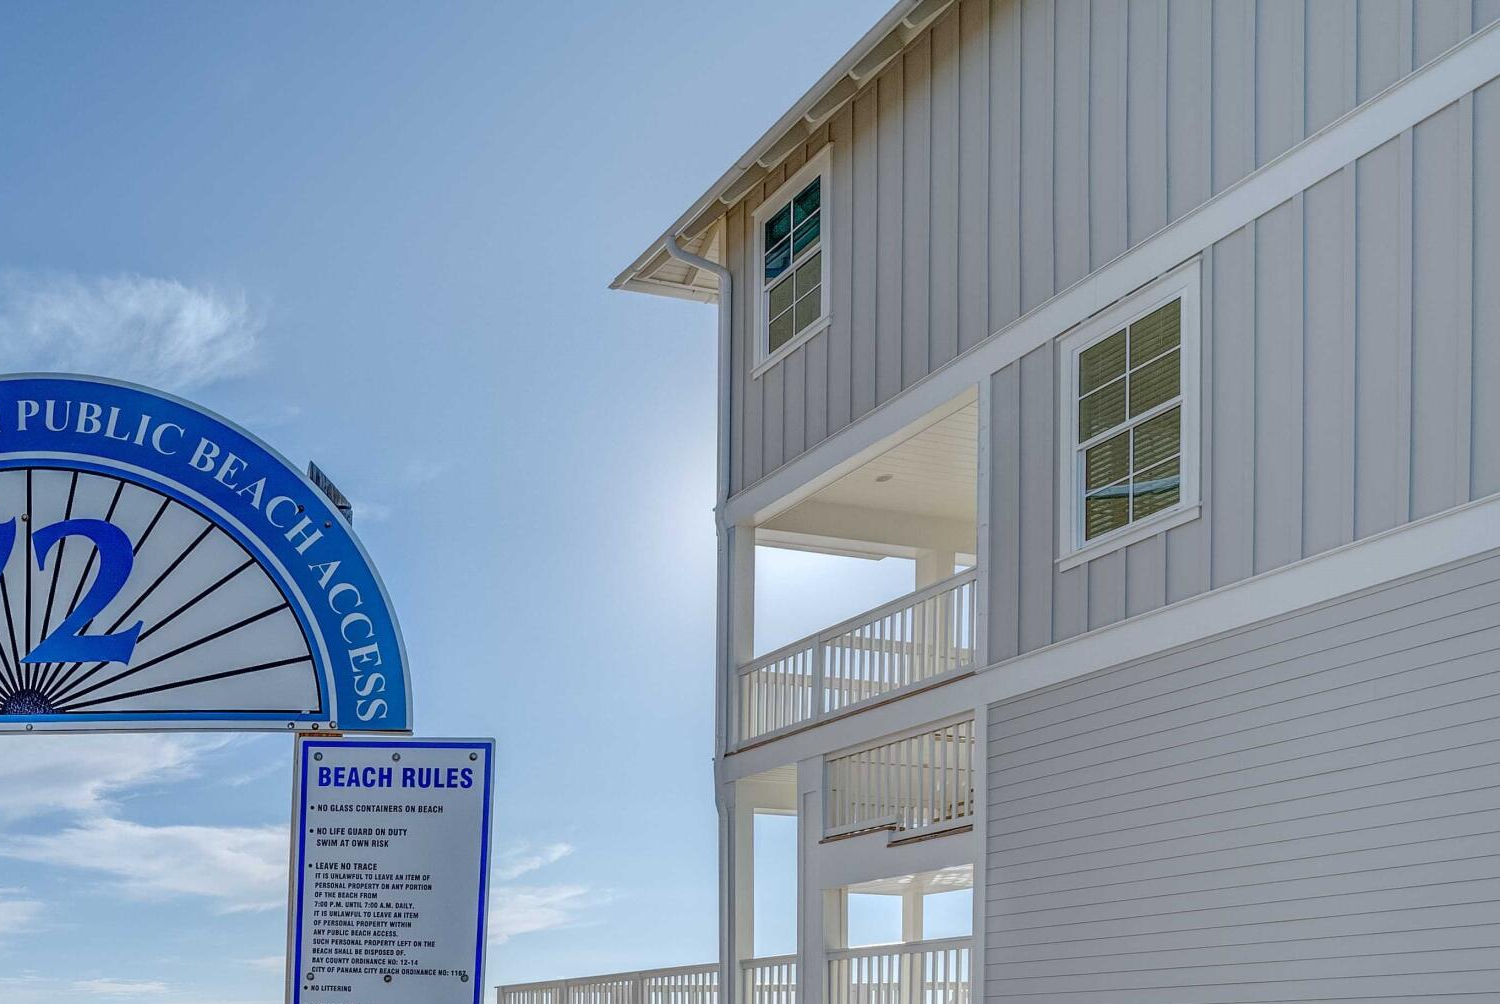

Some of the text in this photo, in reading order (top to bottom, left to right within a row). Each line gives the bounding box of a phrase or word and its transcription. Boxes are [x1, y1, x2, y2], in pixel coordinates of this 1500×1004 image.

[16, 399, 185, 455] PUBLIC
[188, 437, 324, 555] BEACH
[307, 560, 388, 722] ACCESS
[317, 767, 474, 789] BEACH RULES
[317, 804, 328, 812] NO
[355, 805, 402, 813] CONTAINERS
[404, 805, 415, 813] ON
[417, 805, 444, 813] BEACH
[316, 827, 408, 836] NO LIFE GUARD ON DUTY
[316, 839, 389, 848] SWIM AT OWN RISK
[315, 862, 338, 870] LEAVE
